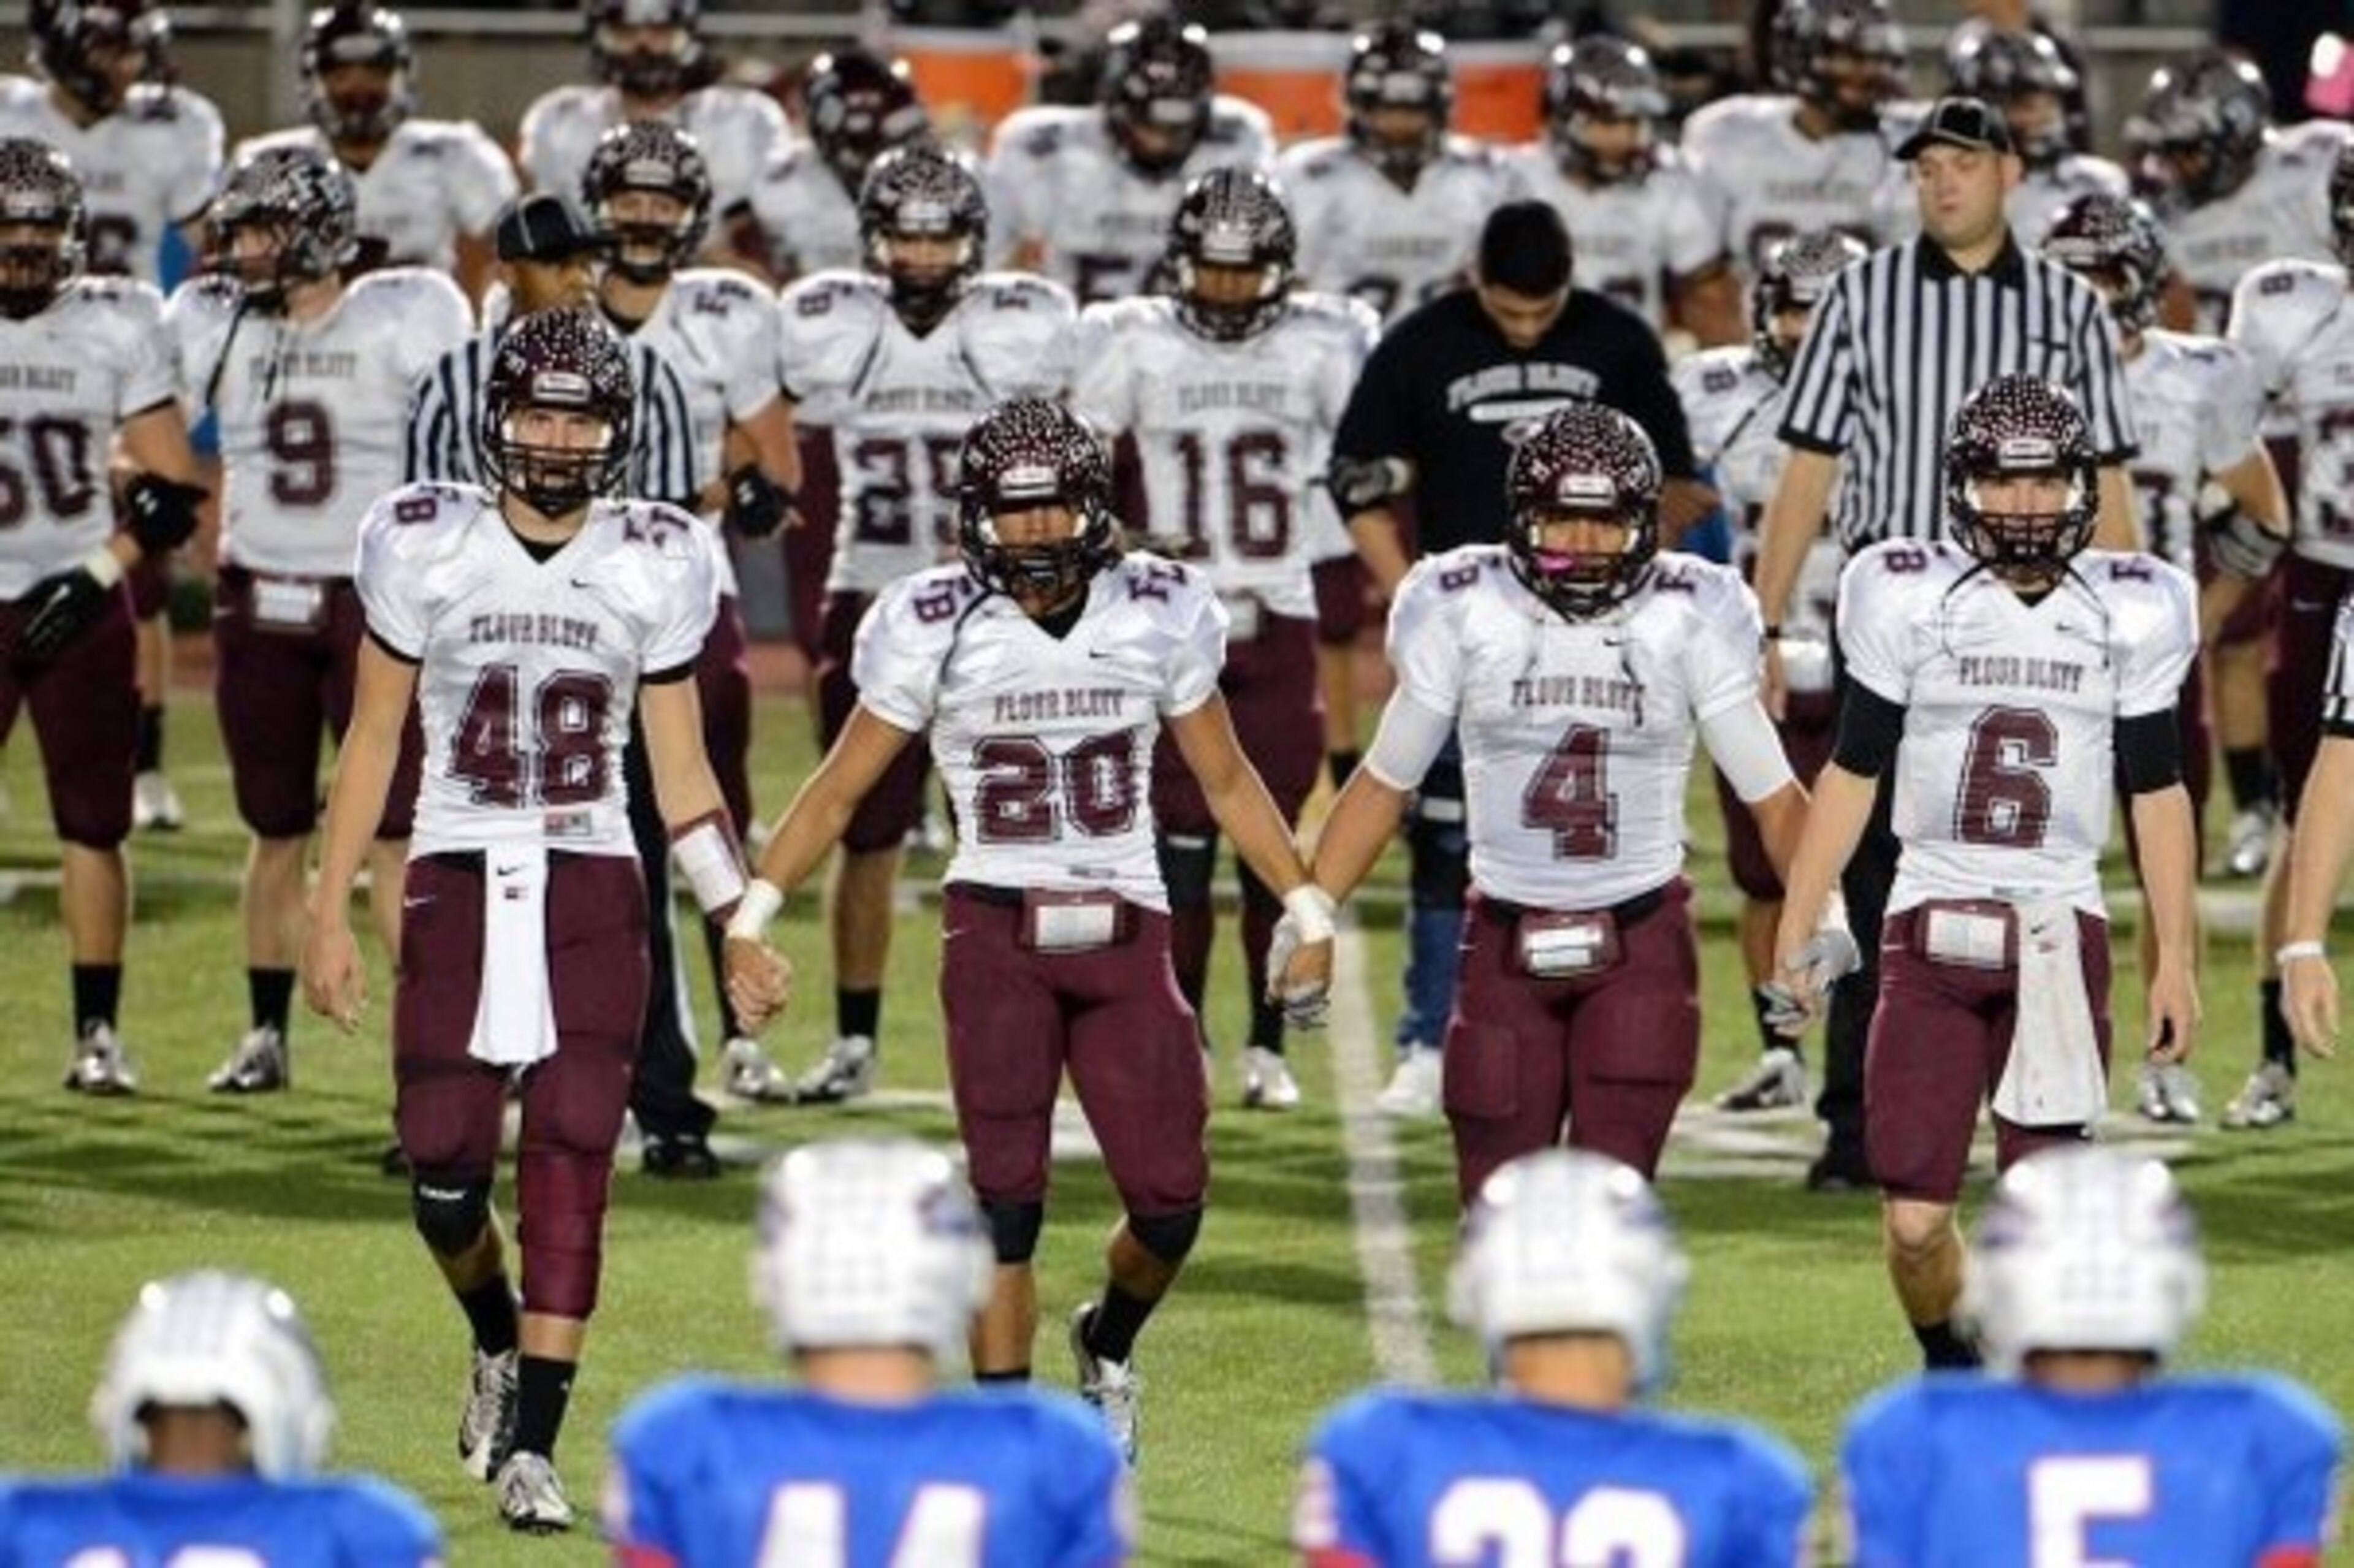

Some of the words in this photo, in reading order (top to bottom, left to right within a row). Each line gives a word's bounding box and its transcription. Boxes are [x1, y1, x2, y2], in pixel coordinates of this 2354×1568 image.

[267, 400, 332, 506] 9
[1176, 431, 1290, 558] 16
[443, 662, 615, 809] 48
[971, 728, 1137, 845] 20
[1521, 723, 1620, 861] 4
[1953, 704, 2059, 851] 6
